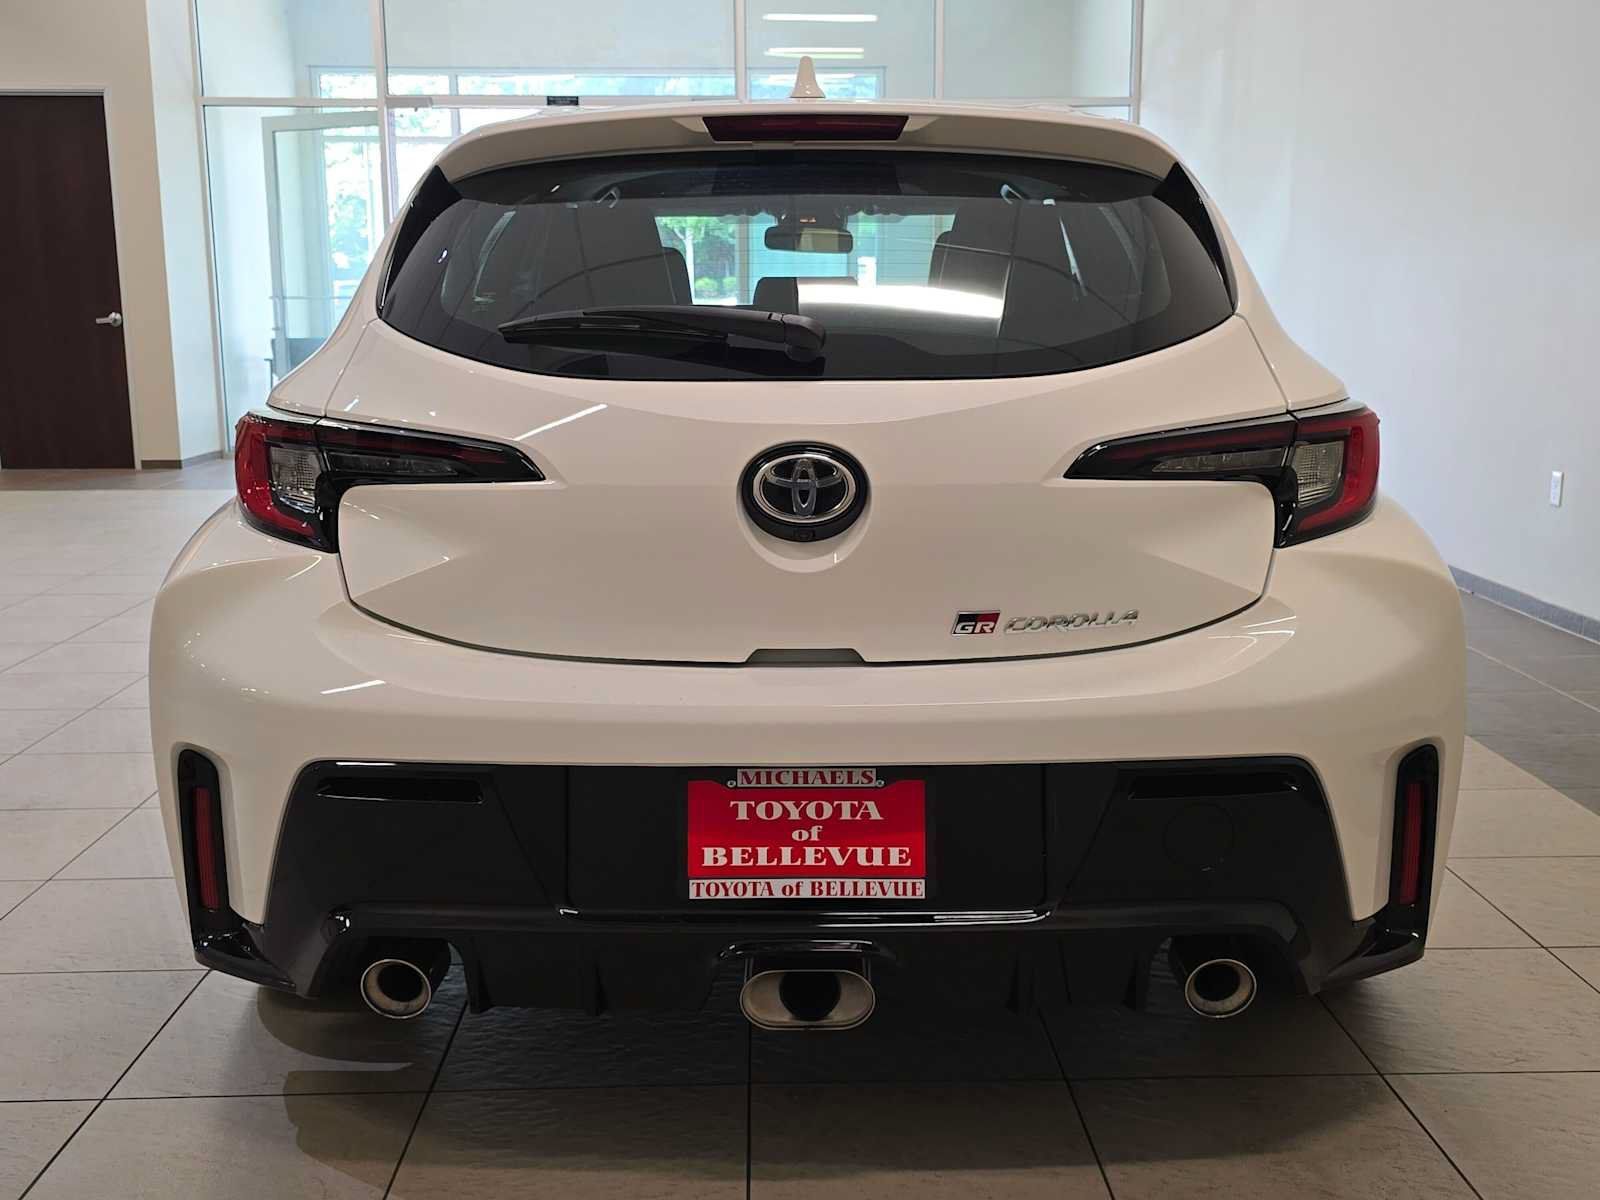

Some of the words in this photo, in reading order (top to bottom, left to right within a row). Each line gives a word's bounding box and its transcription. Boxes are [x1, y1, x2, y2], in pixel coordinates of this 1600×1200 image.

[1005, 609, 1138, 632] COROLLA
[740, 769, 874, 785] MICHAELS
[730, 800, 884, 821] TOYOTA
[791, 825, 823, 841] of
[701, 846, 912, 867] BELLEVUE
[692, 880, 774, 897] TOYOTA
[781, 880, 804, 897] of
[810, 880, 924, 897] BELLEVUE
